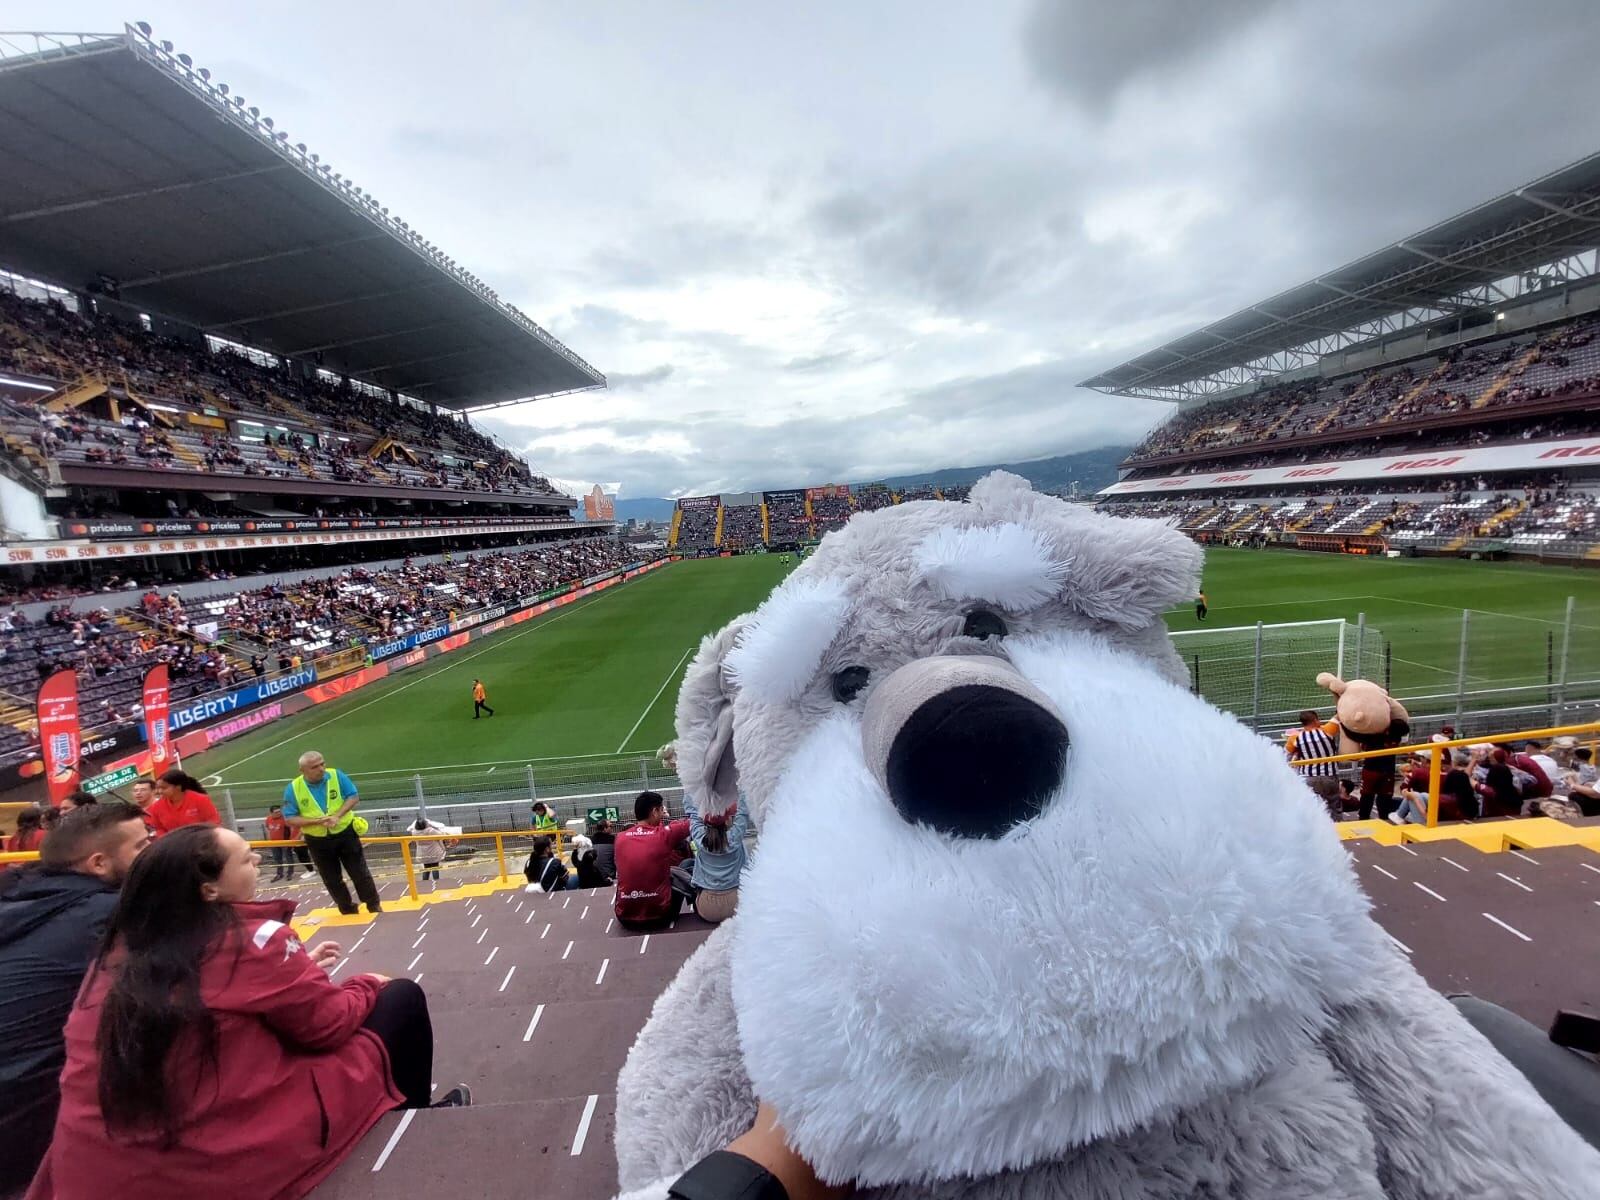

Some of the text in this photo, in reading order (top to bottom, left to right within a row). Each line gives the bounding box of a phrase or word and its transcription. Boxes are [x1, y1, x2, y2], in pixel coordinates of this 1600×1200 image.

[1383, 456, 1465, 471] RCA
[1283, 467, 1341, 478] RCA
[90, 524, 133, 534] priceless
[156, 522, 192, 532] priceless
[210, 521, 241, 530] priceless
[256, 521, 282, 530] priceless
[77, 546, 98, 558] SUR
[107, 545, 127, 556] SUR
[133, 544, 151, 554] SUR
[159, 543, 176, 552] SUR
[8, 550, 34, 562] SUR
[46, 548, 69, 560] SUR
[414, 625, 448, 644] LIBERTY
[371, 639, 409, 660] LIBERTY
[258, 670, 313, 699] LIBERTY
[88, 768, 132, 789] SALIDA DE
